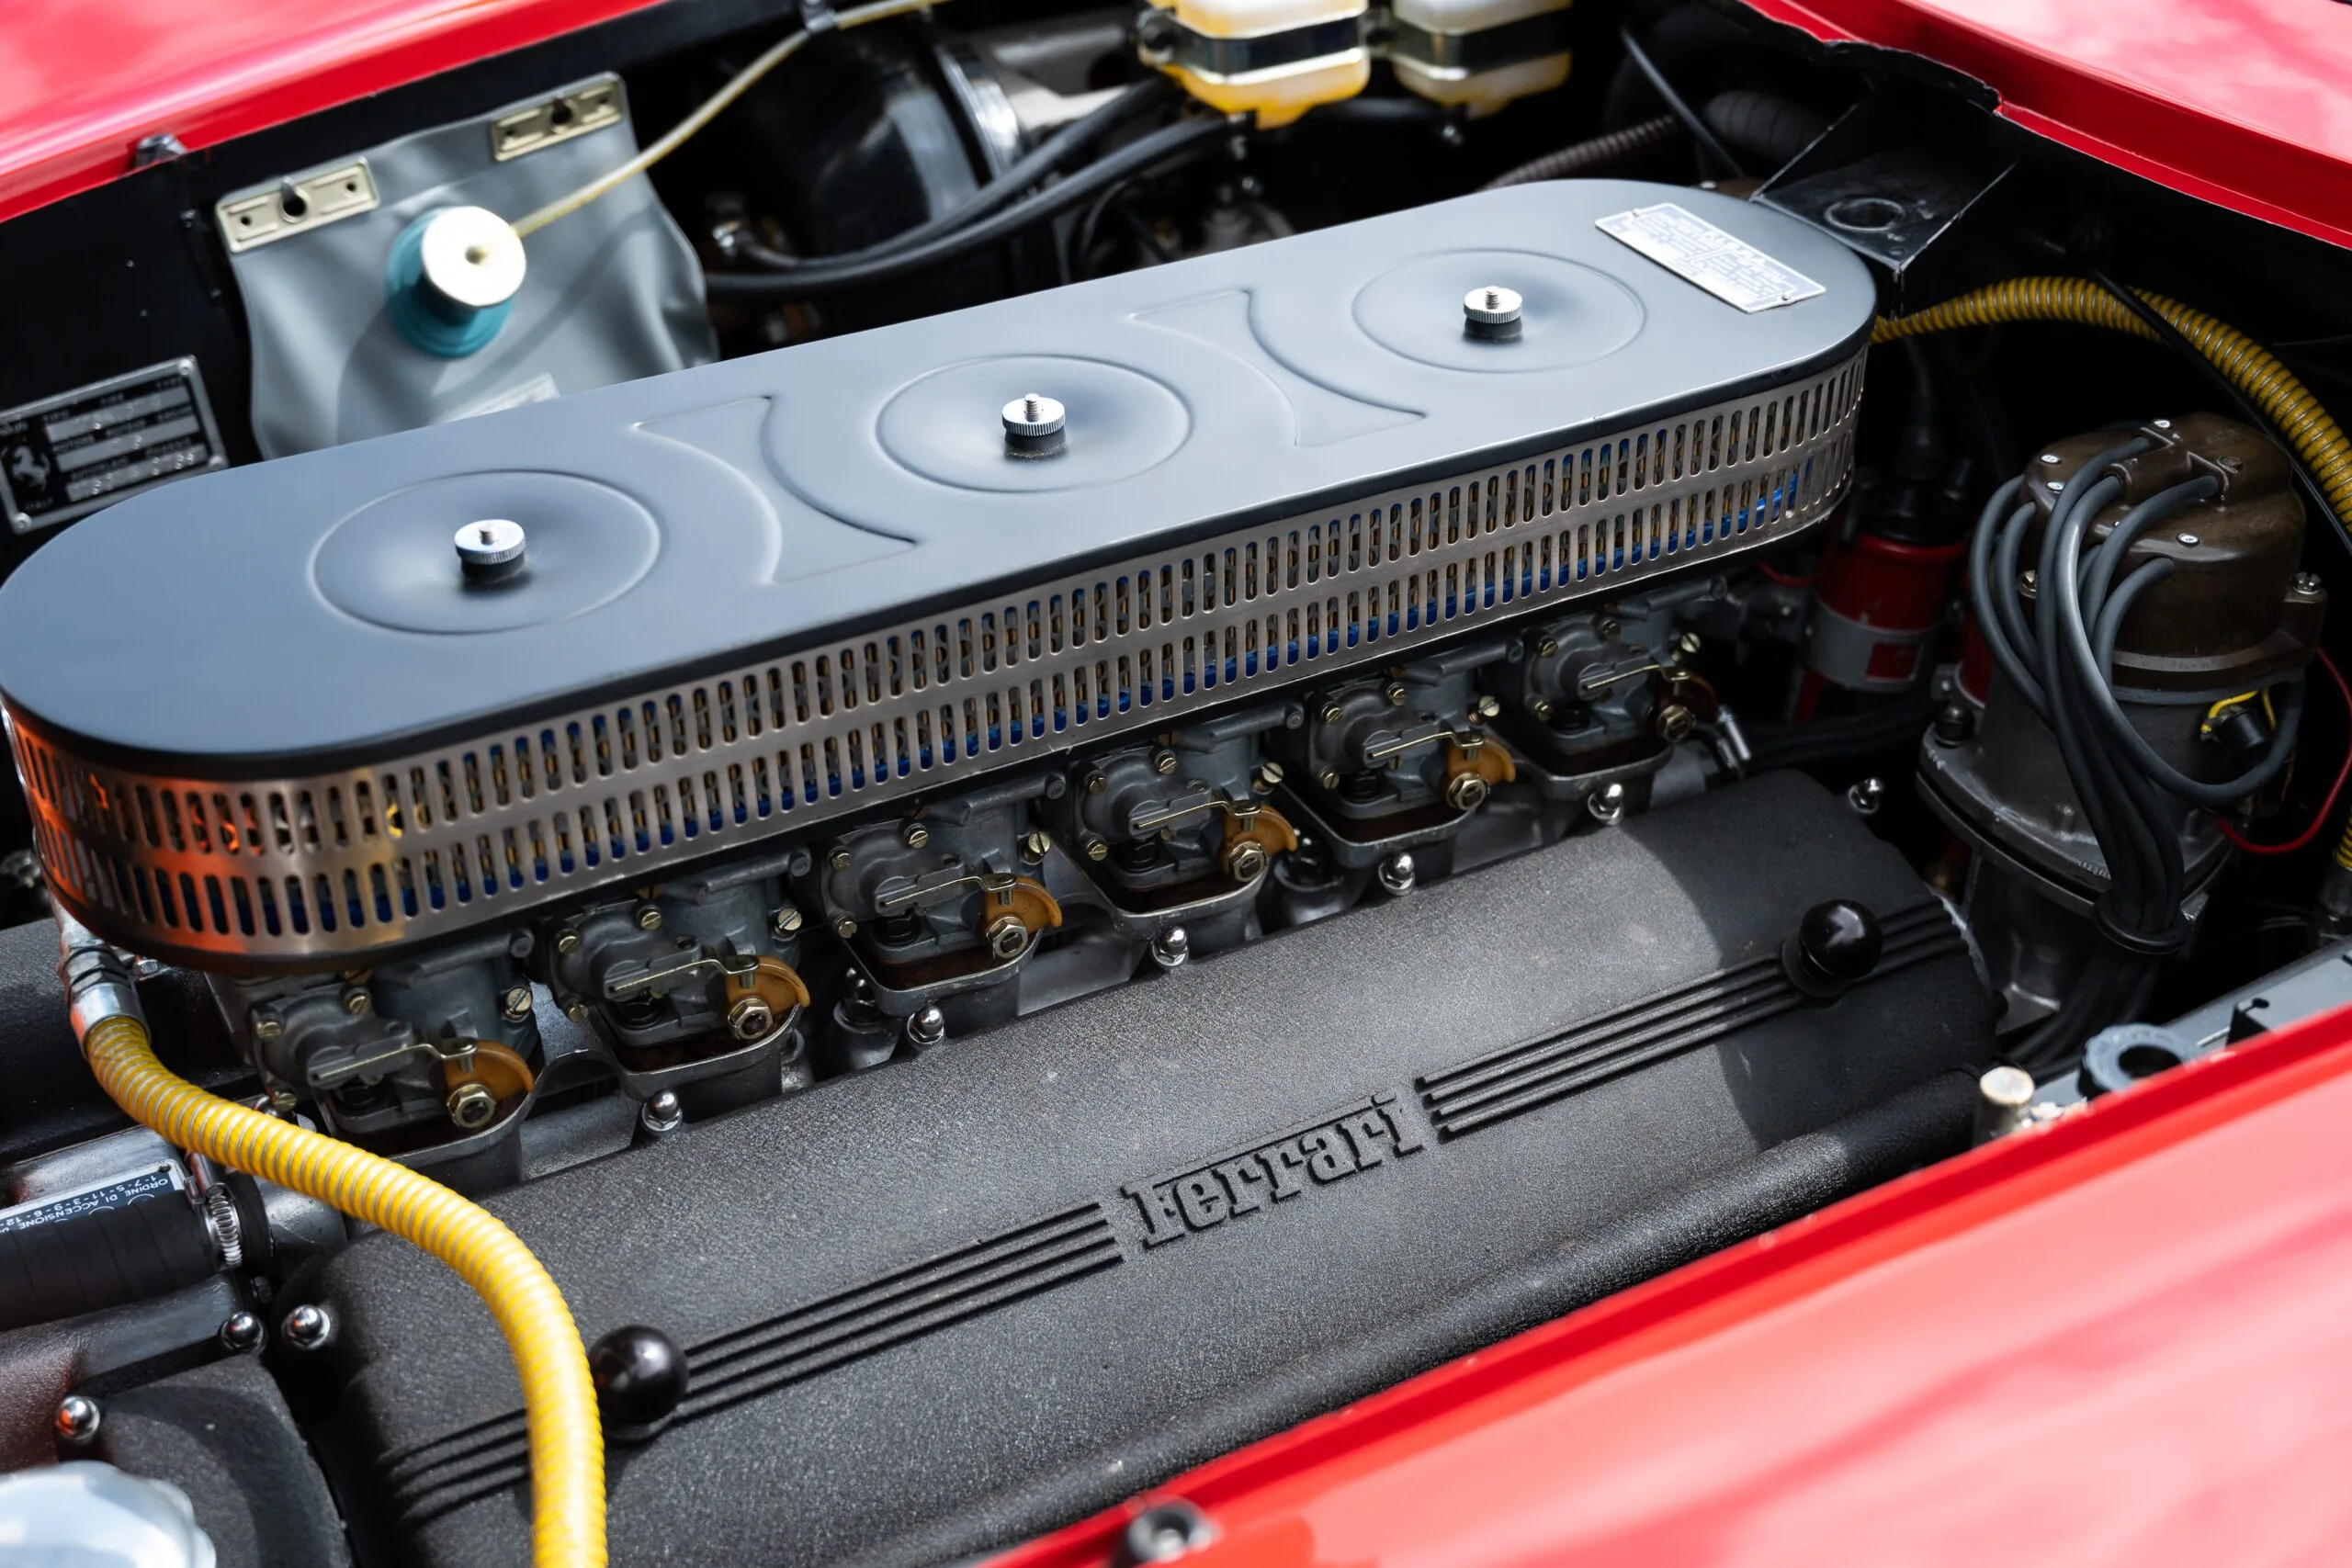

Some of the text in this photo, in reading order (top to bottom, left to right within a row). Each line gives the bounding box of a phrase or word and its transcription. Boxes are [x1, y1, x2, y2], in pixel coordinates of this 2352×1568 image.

[18, 1178, 168, 1230] ORDINE DI ACCENSIONE
[1120, 1089, 1425, 1250] Ferrari
